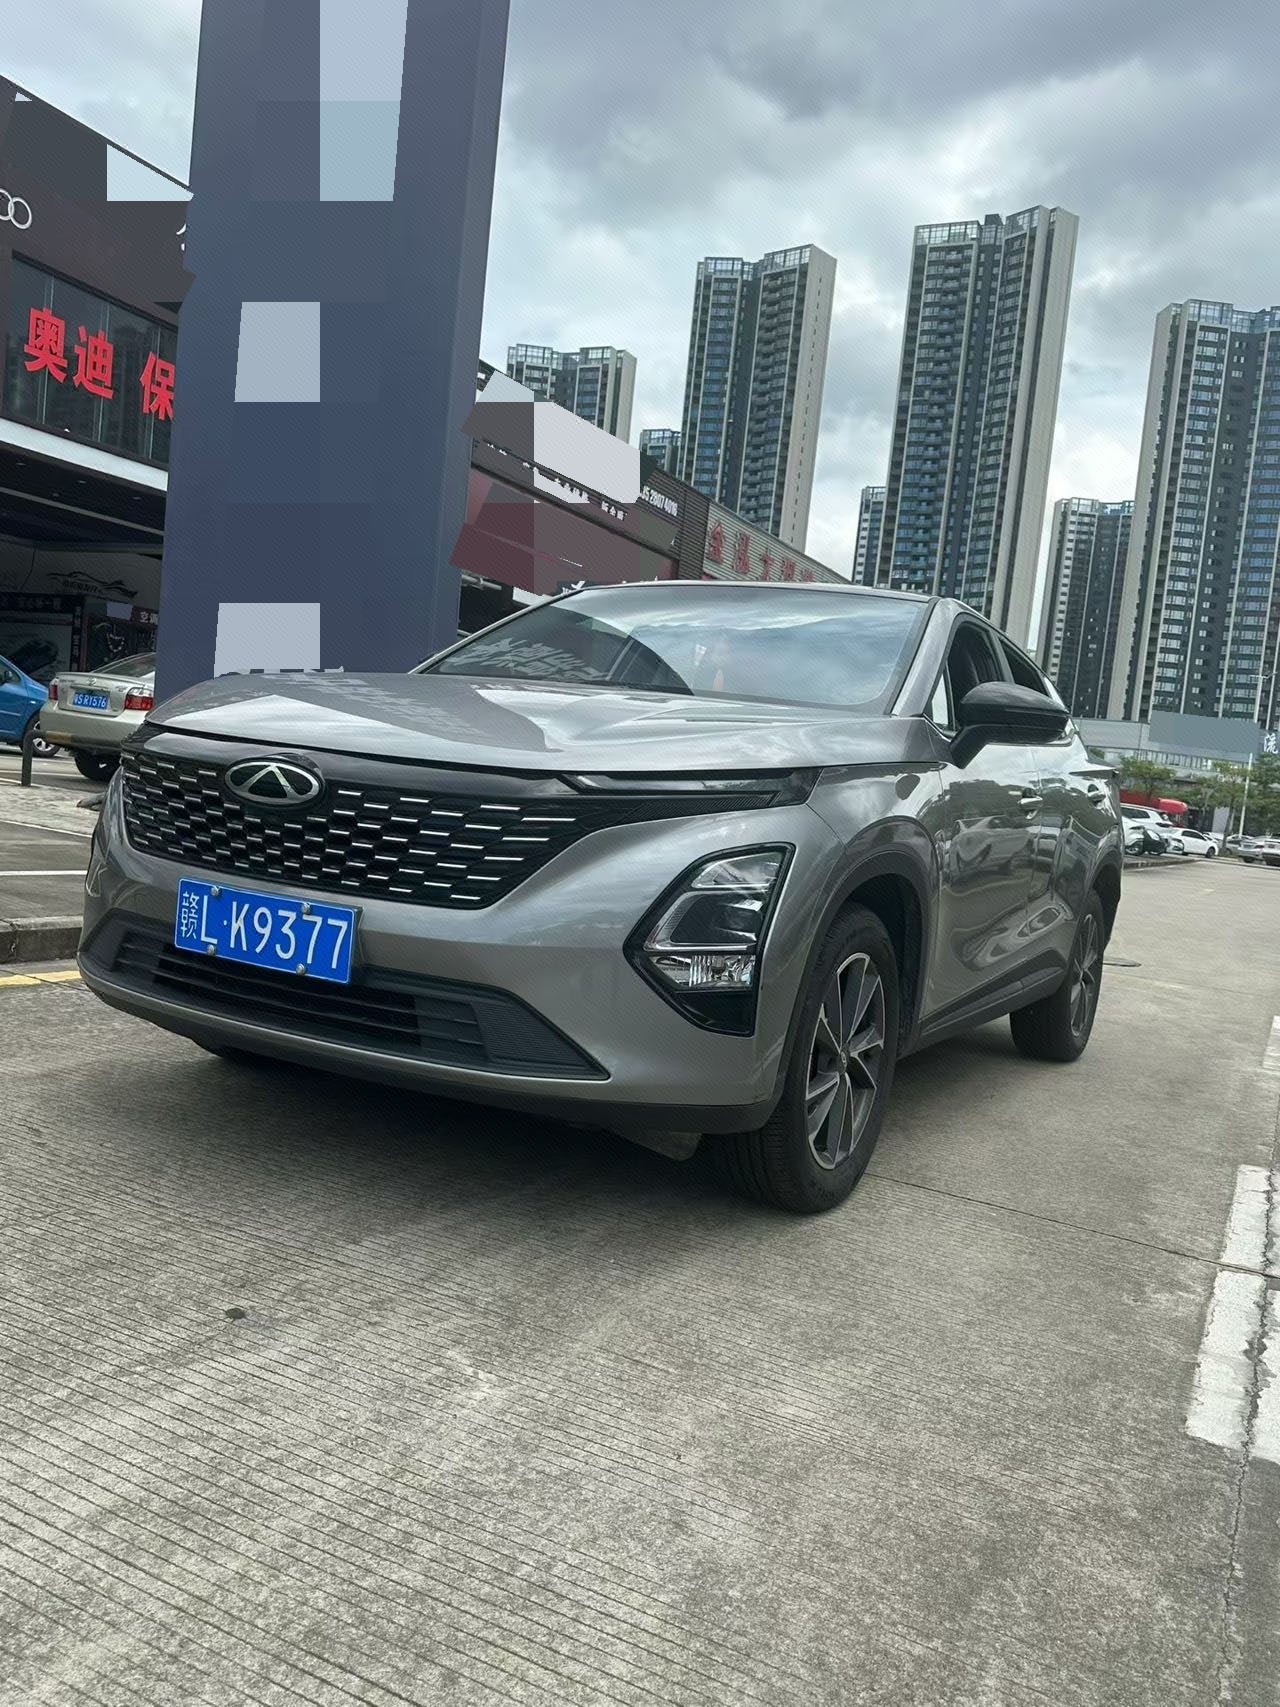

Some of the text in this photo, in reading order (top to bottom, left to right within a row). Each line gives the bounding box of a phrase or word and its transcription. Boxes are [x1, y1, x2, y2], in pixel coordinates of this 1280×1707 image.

[24, 307, 176, 421] 奥迪 保
[181, 890, 349, 970] 赣L·K9377
